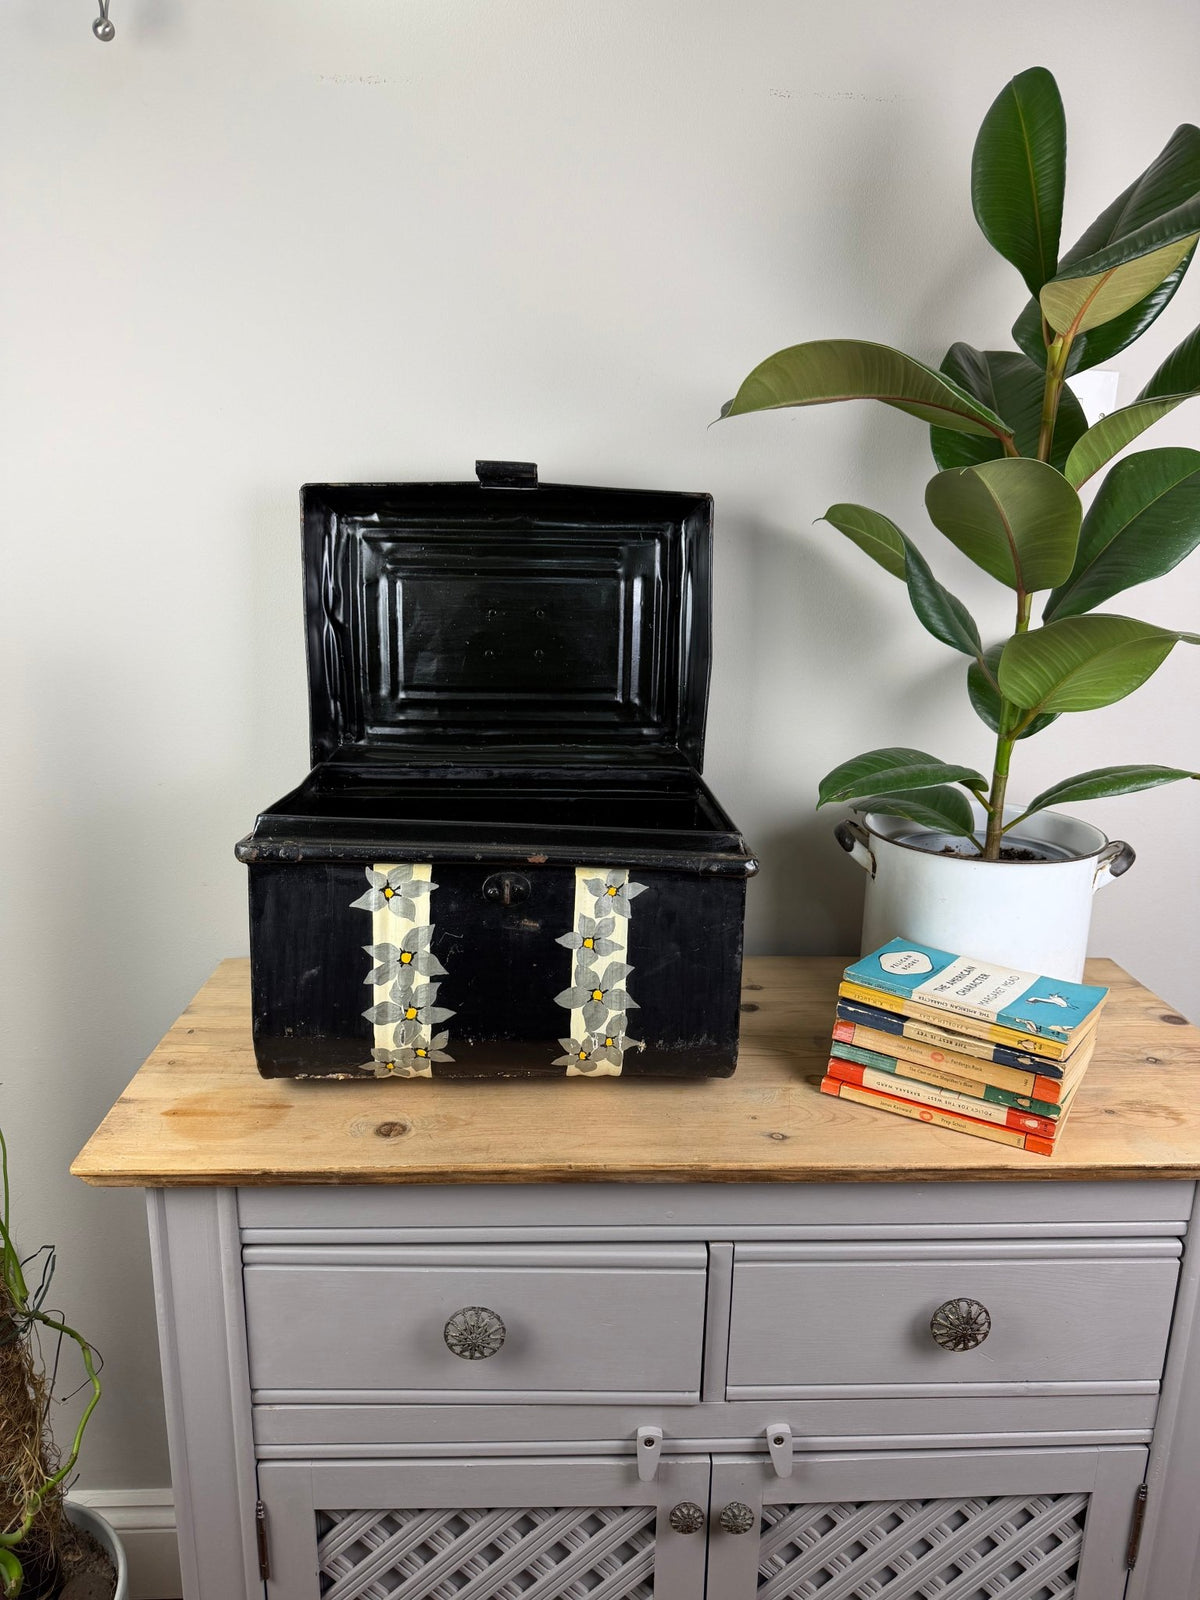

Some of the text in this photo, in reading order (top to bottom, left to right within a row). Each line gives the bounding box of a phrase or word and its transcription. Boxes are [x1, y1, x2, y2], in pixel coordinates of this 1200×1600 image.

[890, 955, 912, 968] PELICAN
[902, 959, 920, 970] BOOKS
[933, 984, 951, 992] THE
[945, 966, 977, 985] AMERICAN
[955, 973, 991, 996] CHARACTER
[977, 975, 1020, 1006] MARGARET MEAD
[918, 996, 948, 1007] CHARACTER
[950, 1004, 978, 1014] AMERICAN
[876, 1081, 893, 1089] WARD
[895, 1087, 921, 1097] BARBARA
[927, 1095, 943, 1104] WEST
[971, 1107, 993, 1117] POLICY
[952, 1121, 967, 1129] School
